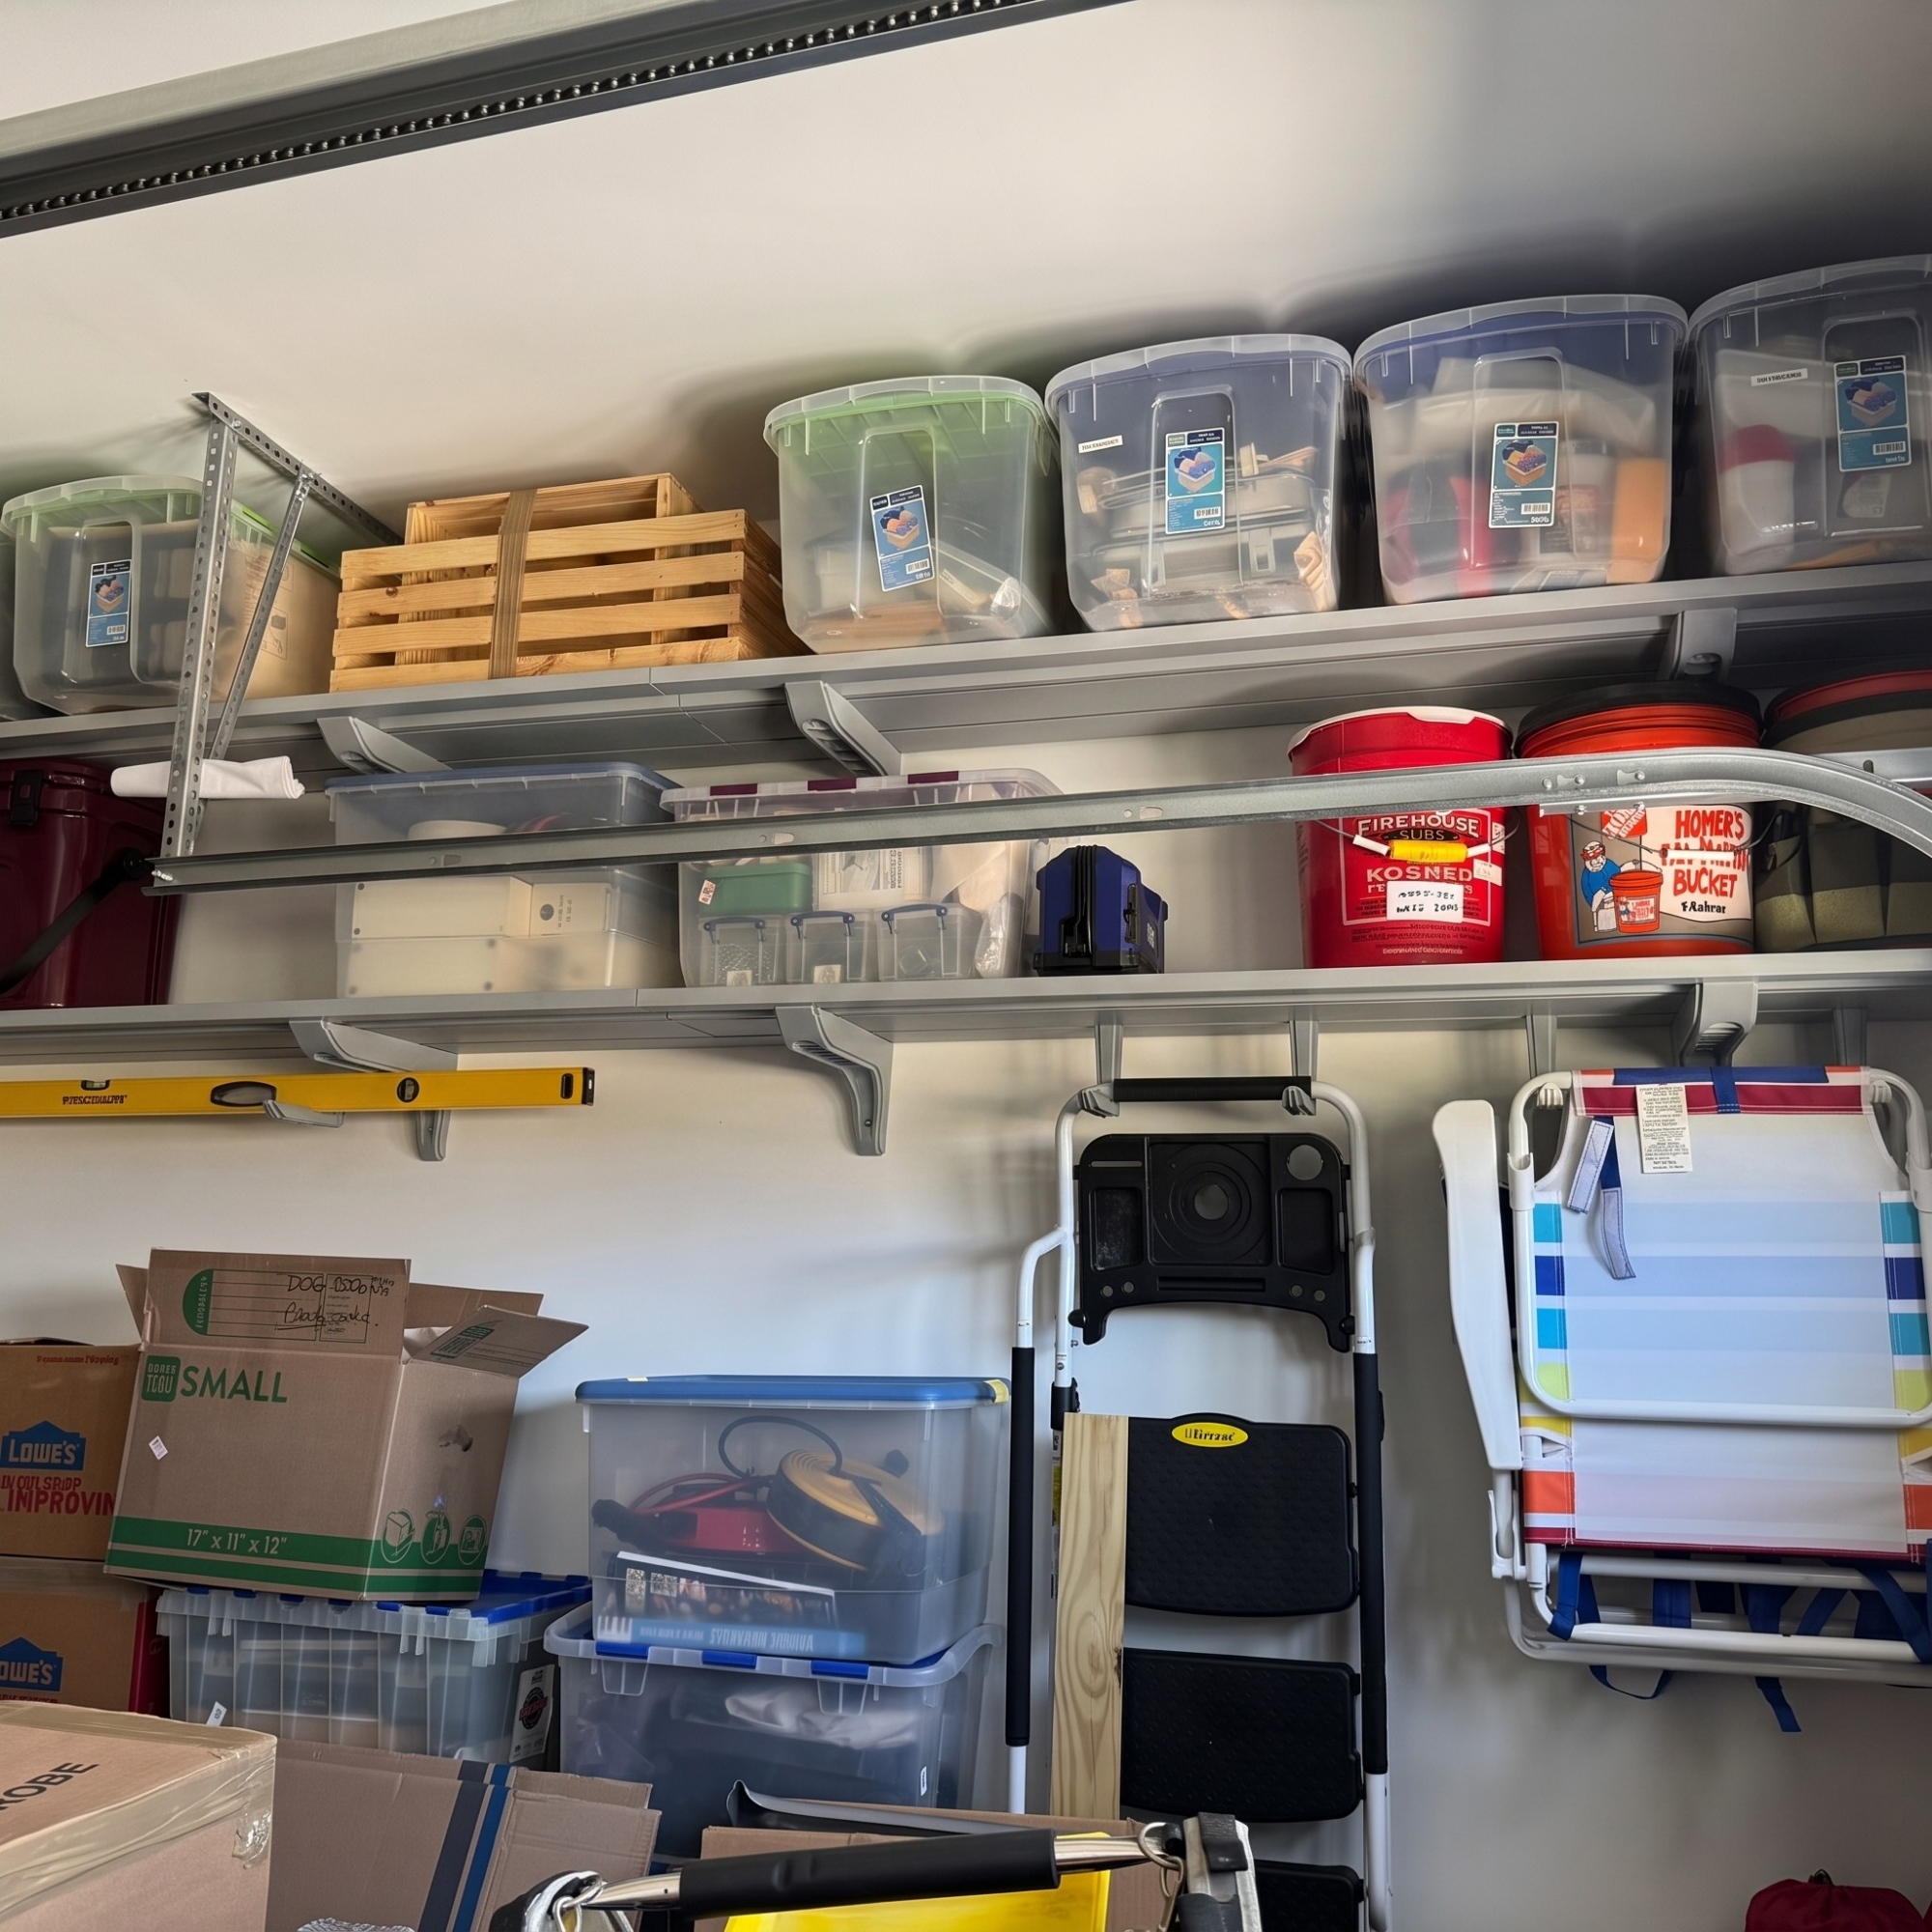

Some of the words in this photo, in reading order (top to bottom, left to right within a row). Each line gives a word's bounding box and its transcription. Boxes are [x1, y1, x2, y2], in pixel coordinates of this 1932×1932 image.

[1357, 814, 1480, 838] FIREHOUSE
[1400, 830, 1445, 840] SUBS
[1675, 810, 1745, 840] HOMER'S
[1366, 866, 1473, 882] KOSNED
[1673, 867, 1738, 898] BUCKET
[181, 1365, 288, 1404] SMALL
[8, 1439, 77, 1465] LOWE'S
